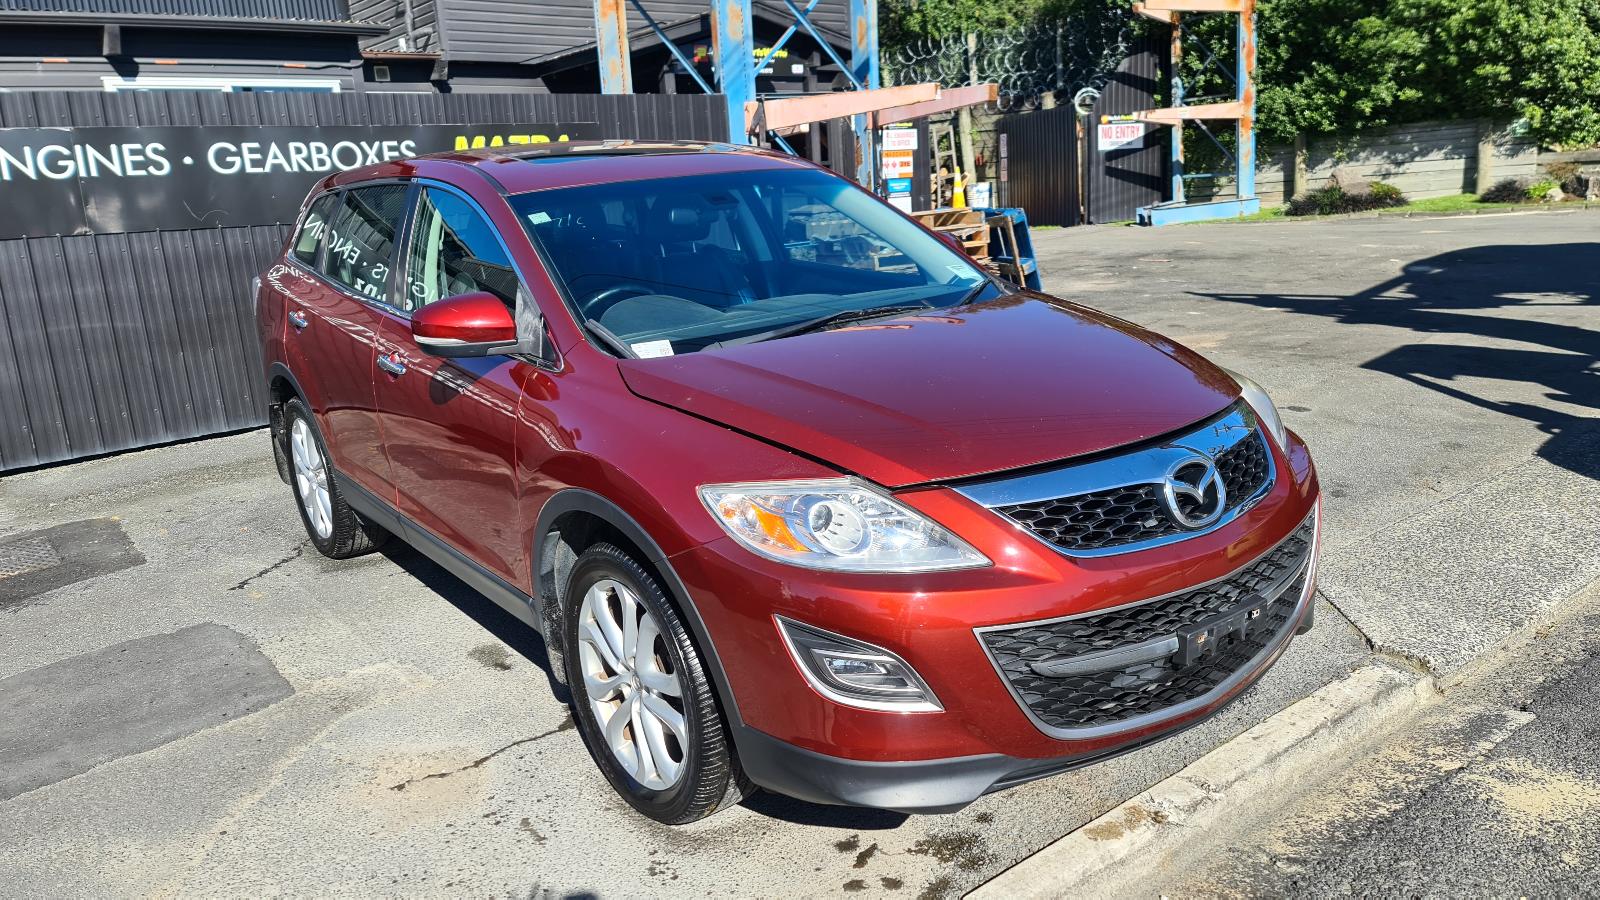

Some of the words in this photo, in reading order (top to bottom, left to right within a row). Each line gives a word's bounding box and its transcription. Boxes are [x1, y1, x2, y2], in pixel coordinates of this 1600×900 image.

[1101, 127, 1112, 140] NO
[1115, 125, 1140, 139] ENTRY
[207, 140, 417, 174] GEARBOXES
